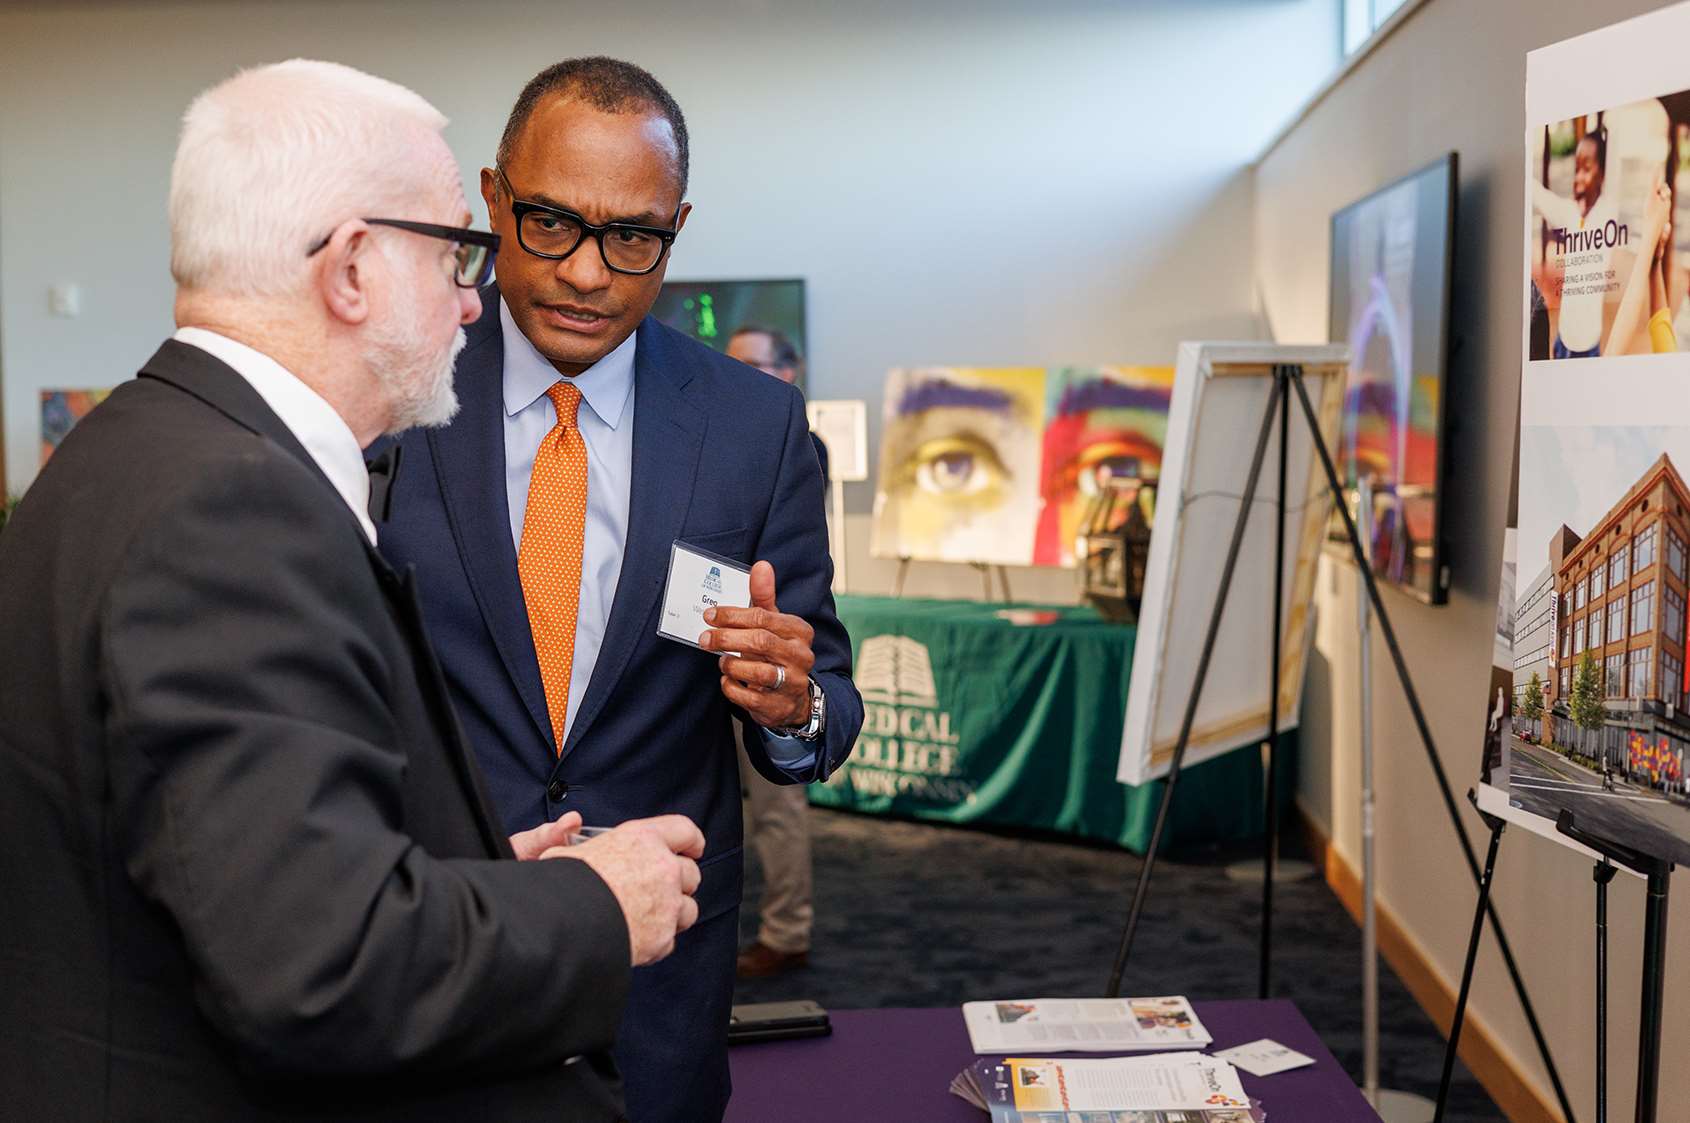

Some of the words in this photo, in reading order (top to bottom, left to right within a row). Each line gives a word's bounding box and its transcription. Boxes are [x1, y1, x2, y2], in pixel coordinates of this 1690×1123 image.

[1552, 219, 1628, 255] ThriveOn
[1555, 254, 1603, 268] COLLABORATION
[1555, 274, 1579, 287] SHARING
[1585, 271, 1603, 282] VISION
[1605, 269, 1616, 280] FOR
[1560, 286, 1585, 297] THRIVING
[1586, 282, 1620, 295] COMMUNITY
[863, 703, 960, 744] EDCAL
